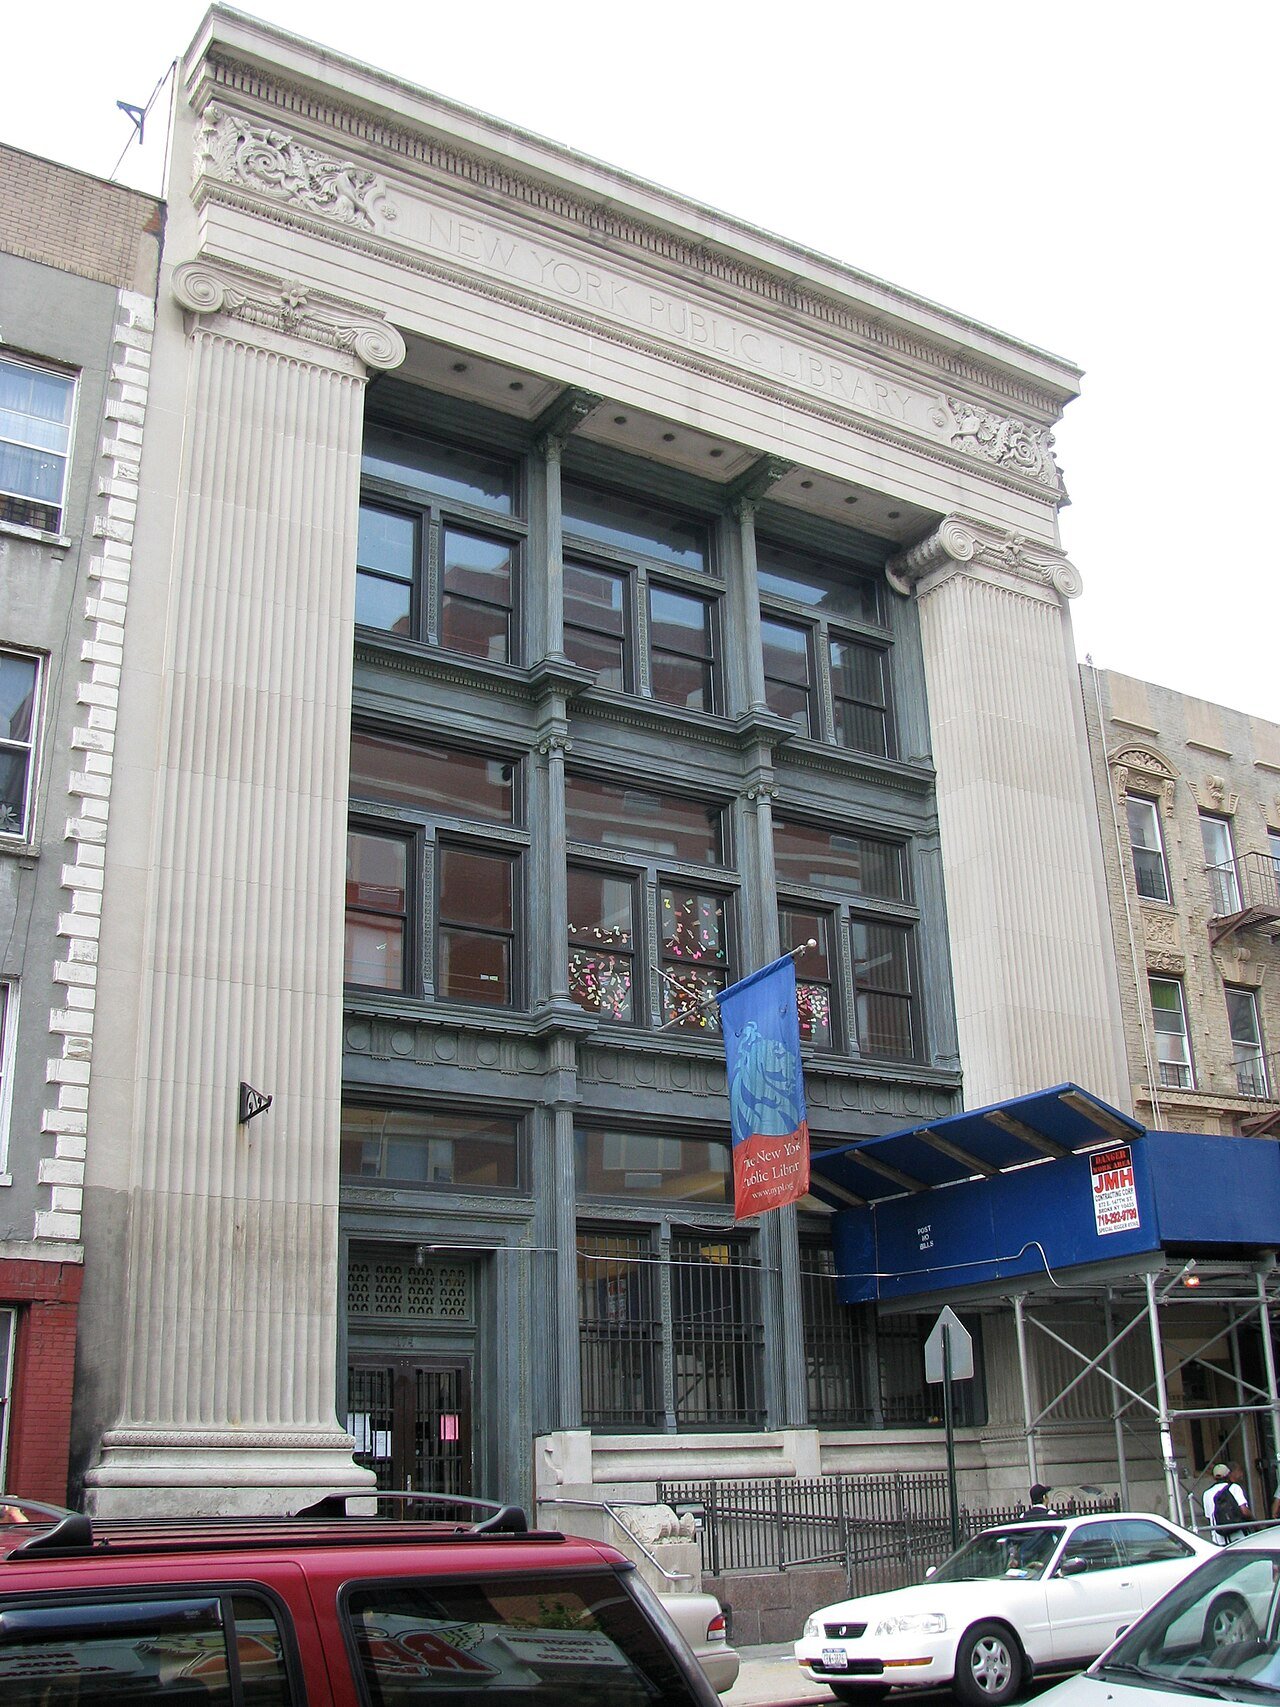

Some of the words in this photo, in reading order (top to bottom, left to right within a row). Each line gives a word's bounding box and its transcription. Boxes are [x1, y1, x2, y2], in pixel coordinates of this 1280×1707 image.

[428, 212, 518, 268] NEW
[531, 251, 631, 315] YORK
[649, 295, 762, 364] PUBLIC
[778, 345, 912, 420] LIBRARY
[757, 1149, 781, 1163] New
[1095, 1150, 1126, 1164] DANGER
[1113, 1159, 1131, 1169] AREA
[1094, 1168, 1133, 1193] JMH
[1095, 1190, 1122, 1202] CONTRACTING
[917, 1225, 932, 1235] POST
[921, 1234, 930, 1242] NO
[920, 1240, 934, 1250] BILLS
